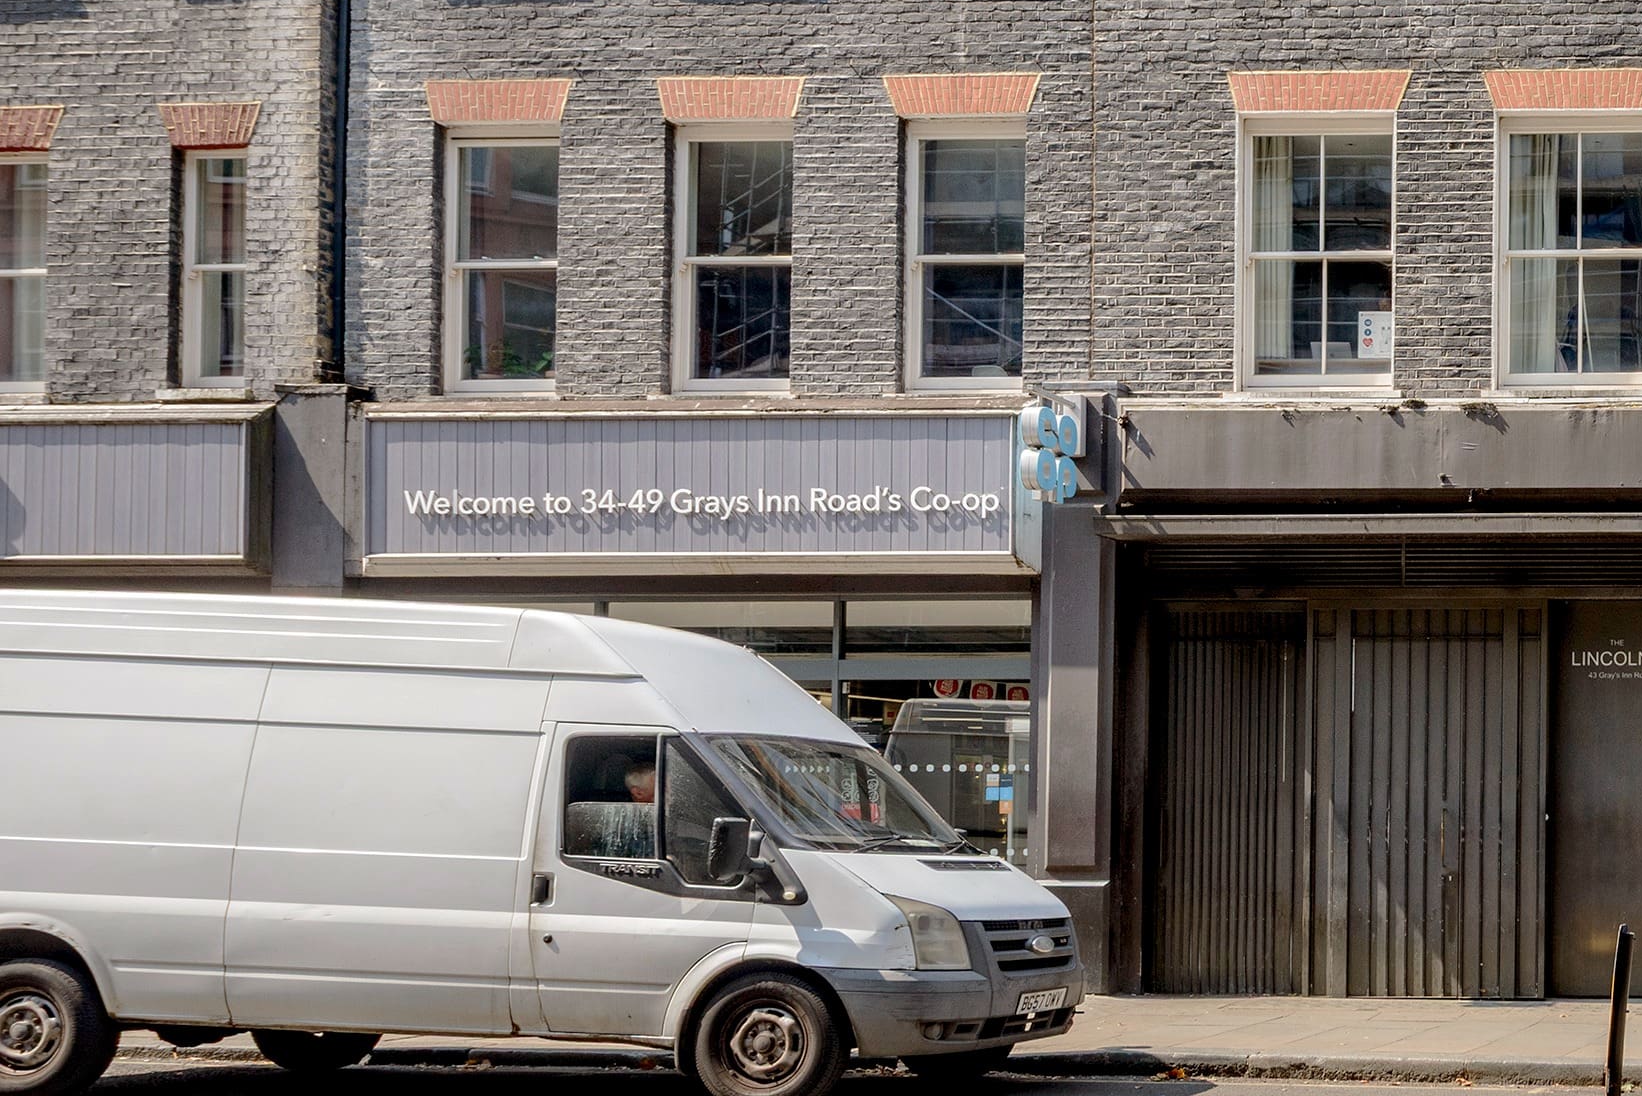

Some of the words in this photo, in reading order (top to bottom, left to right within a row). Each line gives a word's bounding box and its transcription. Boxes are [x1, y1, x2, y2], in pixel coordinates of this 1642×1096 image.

[403, 488, 535, 515] Welcome
[543, 491, 572, 514] to
[580, 488, 664, 514] 34-49
[670, 488, 750, 520] Grays
[758, 488, 800, 513] Inn
[810, 485, 902, 512] Road's
[910, 486, 1000, 519] Co-op
[1610, 639, 1625, 647] THE
[1598, 671, 1621, 681] Gray's
[1621, 671, 1633, 679] Inn
[600, 863, 661, 876] TRANSIT
